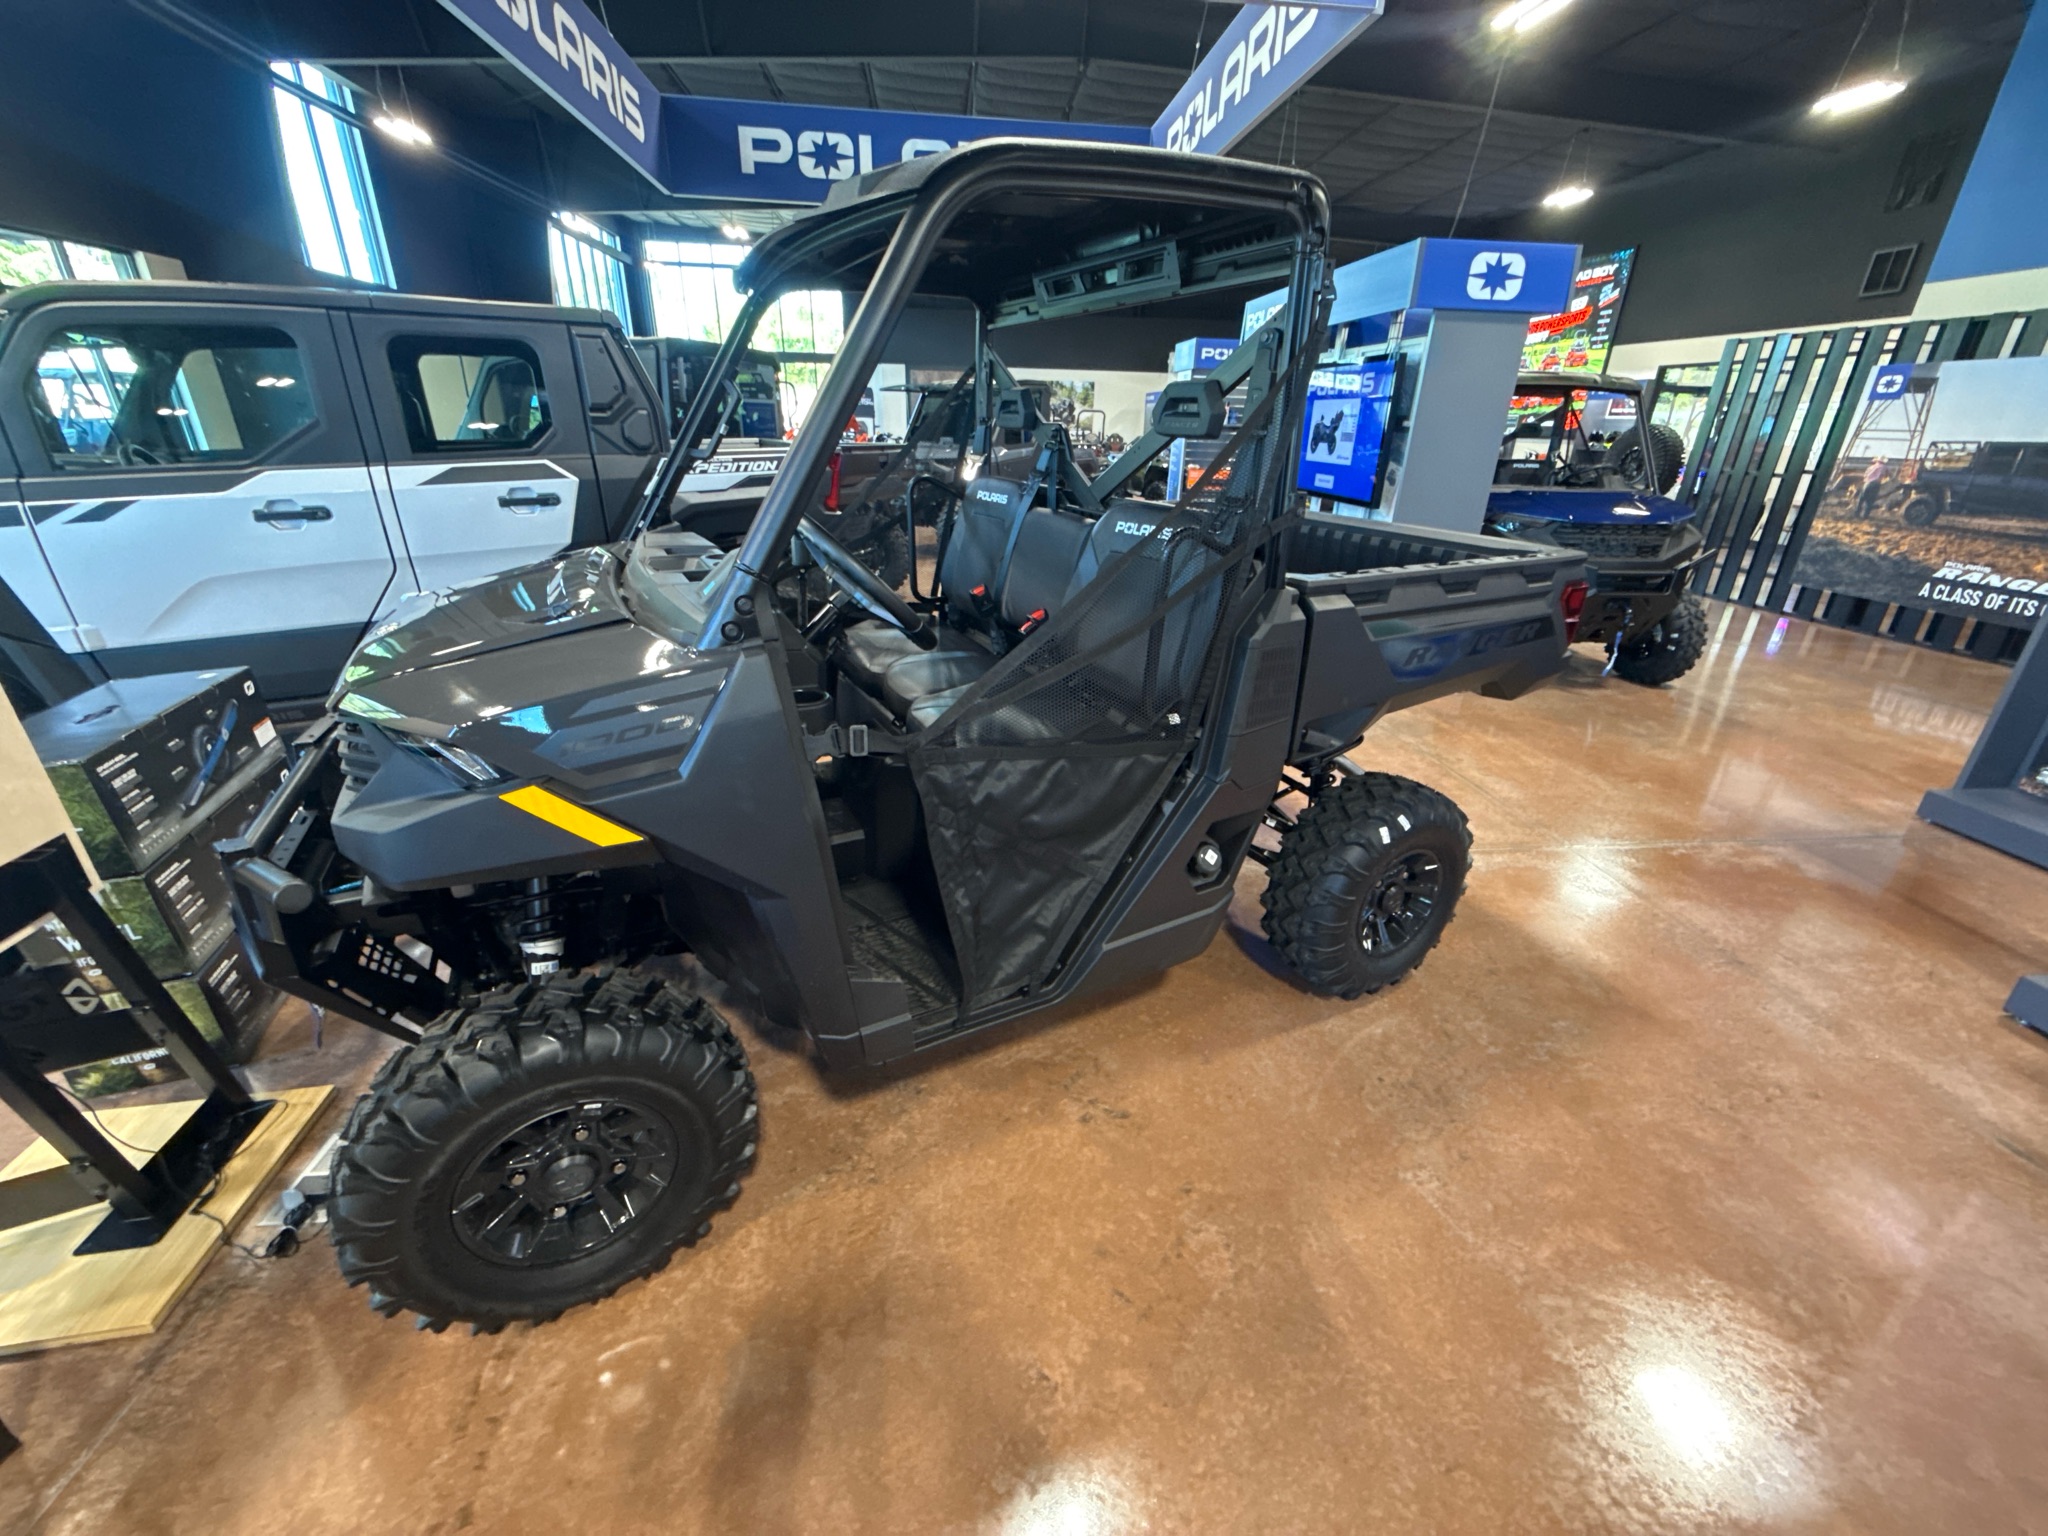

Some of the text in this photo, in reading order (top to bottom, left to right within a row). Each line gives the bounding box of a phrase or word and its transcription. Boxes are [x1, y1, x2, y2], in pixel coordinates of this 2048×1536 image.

[495, 0, 645, 143] LARIS
[1576, 269, 1592, 282] AD
[976, 490, 1009, 505] POLARIS
[1115, 521, 1174, 540] POLAS
[1944, 561, 1992, 573] POLARIS
[1918, 582, 1931, 598] A
[1932, 584, 1983, 607] CLASS
[1983, 593, 2010, 611] OF
[2007, 597, 2039, 617] ITS
[111, 1047, 169, 1065] CALIFORNI
